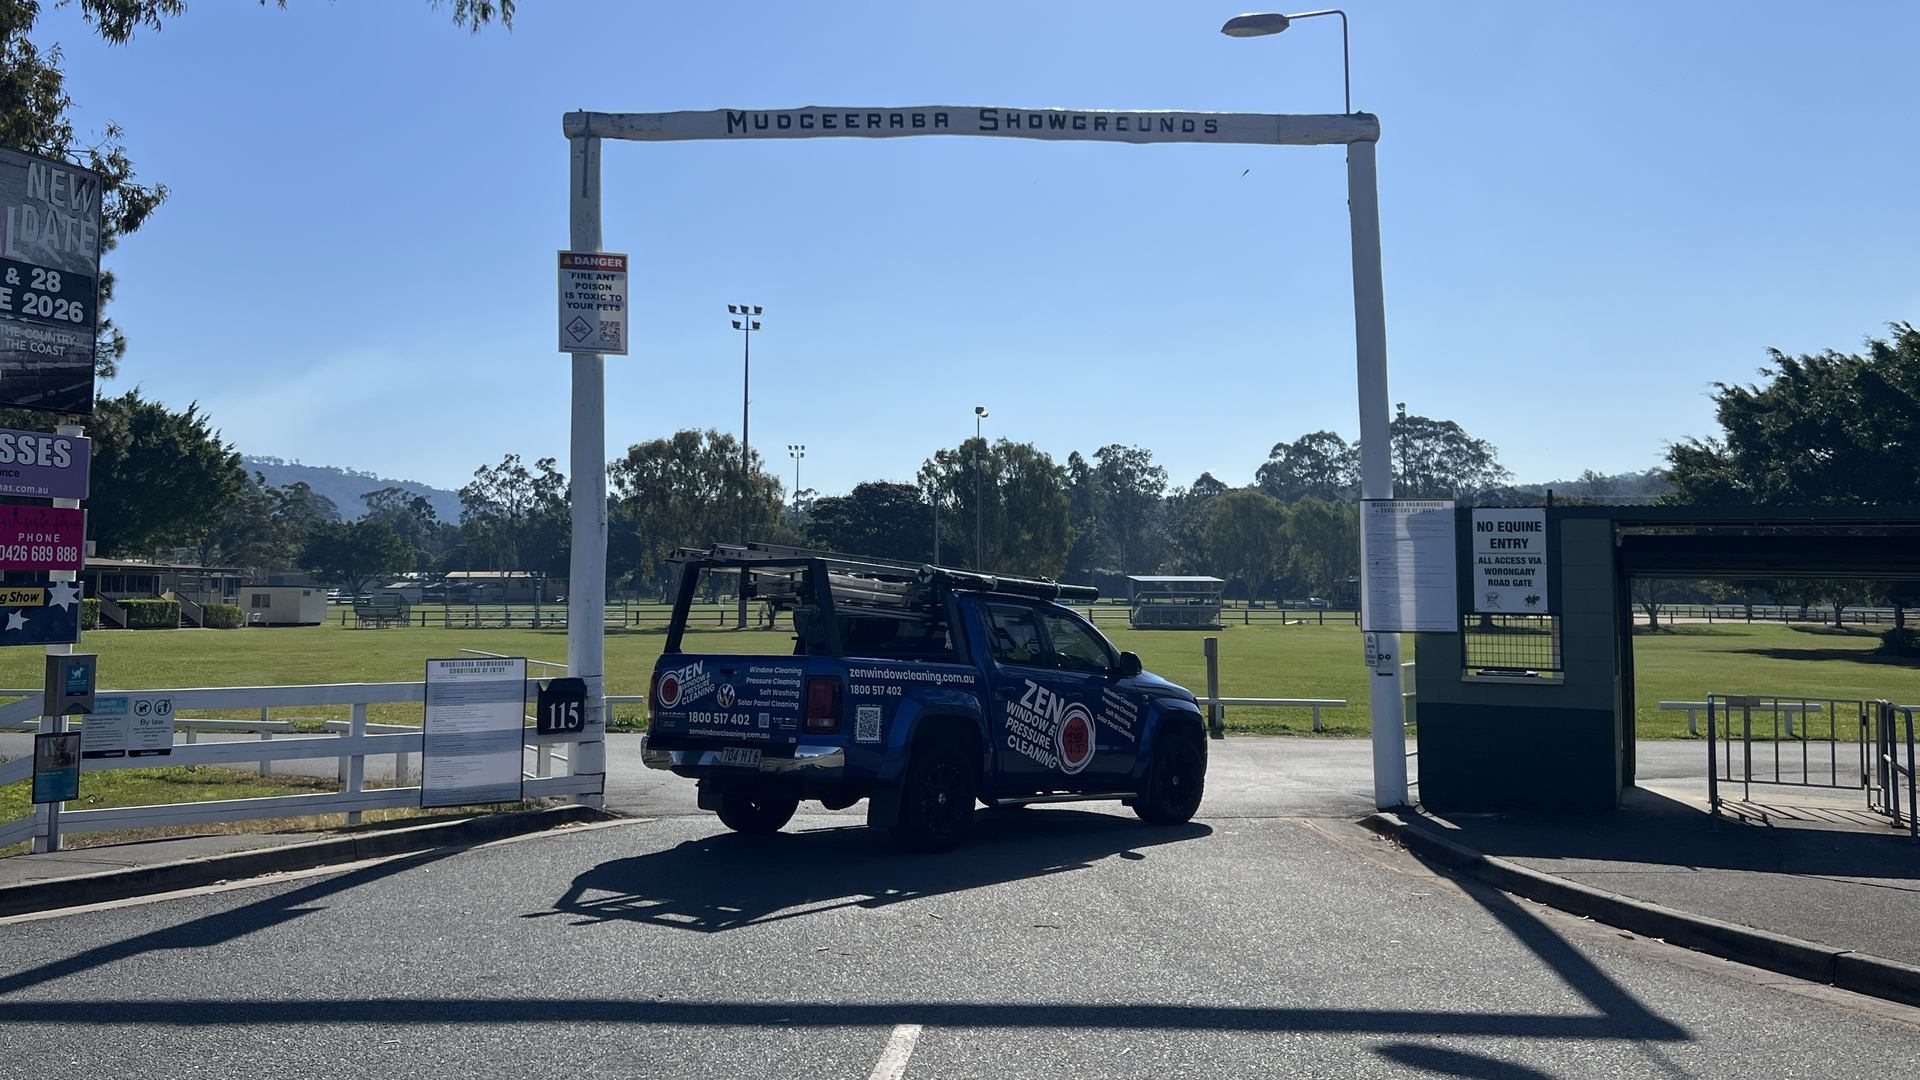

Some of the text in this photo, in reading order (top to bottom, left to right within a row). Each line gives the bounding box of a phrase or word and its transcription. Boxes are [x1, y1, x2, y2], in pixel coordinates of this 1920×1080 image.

[726, 111, 949, 134] MUDGEERABA
[27, 162, 94, 213] NEW
[21, 203, 95, 258] DATE
[574, 256, 623, 268] DANGER
[5, 267, 61, 293] & 28
[571, 272, 593, 280] FIRE
[575, 282, 612, 291] POISON
[565, 291, 622, 302] IS TOXIC TO
[21, 292, 84, 323] 2026
[566, 301, 621, 311] YOUR PETS
[5, 337, 66, 357] THE COAST
[1477, 521, 1542, 533] NO EQUINE
[18, 532, 61, 543] PHONE
[1490, 538, 1529, 549] ENTRY
[31, 545, 53, 562] 689
[56, 546, 77, 562] 888
[1478, 556, 1543, 565] ALL ACCESS VIA
[1484, 567, 1536, 576] WORONGARY
[1487, 578, 1533, 587] ROAD GATE
[9, 591, 40, 603] Show
[678, 659, 704, 685] ZEN
[774, 666, 802, 677] Cleaning
[849, 667, 975, 685] zenwindowcleaning.com.au
[746, 676, 801, 688] Pressure Cleaning
[681, 683, 716, 706] CLEANING
[759, 688, 800, 700] Soft Washing
[850, 684, 902, 696] 1800 517 402
[737, 698, 799, 711] Solar Panel Cleaning
[1020, 678, 1065, 724] ZEN
[548, 701, 579, 730] 115
[688, 711, 750, 725] 1800 517 402
[1006, 699, 1056, 737] WINDOW &
[140, 718, 149, 728] By
[1005, 716, 1051, 750] PRESSURE
[1007, 734, 1058, 769] CLEANING
